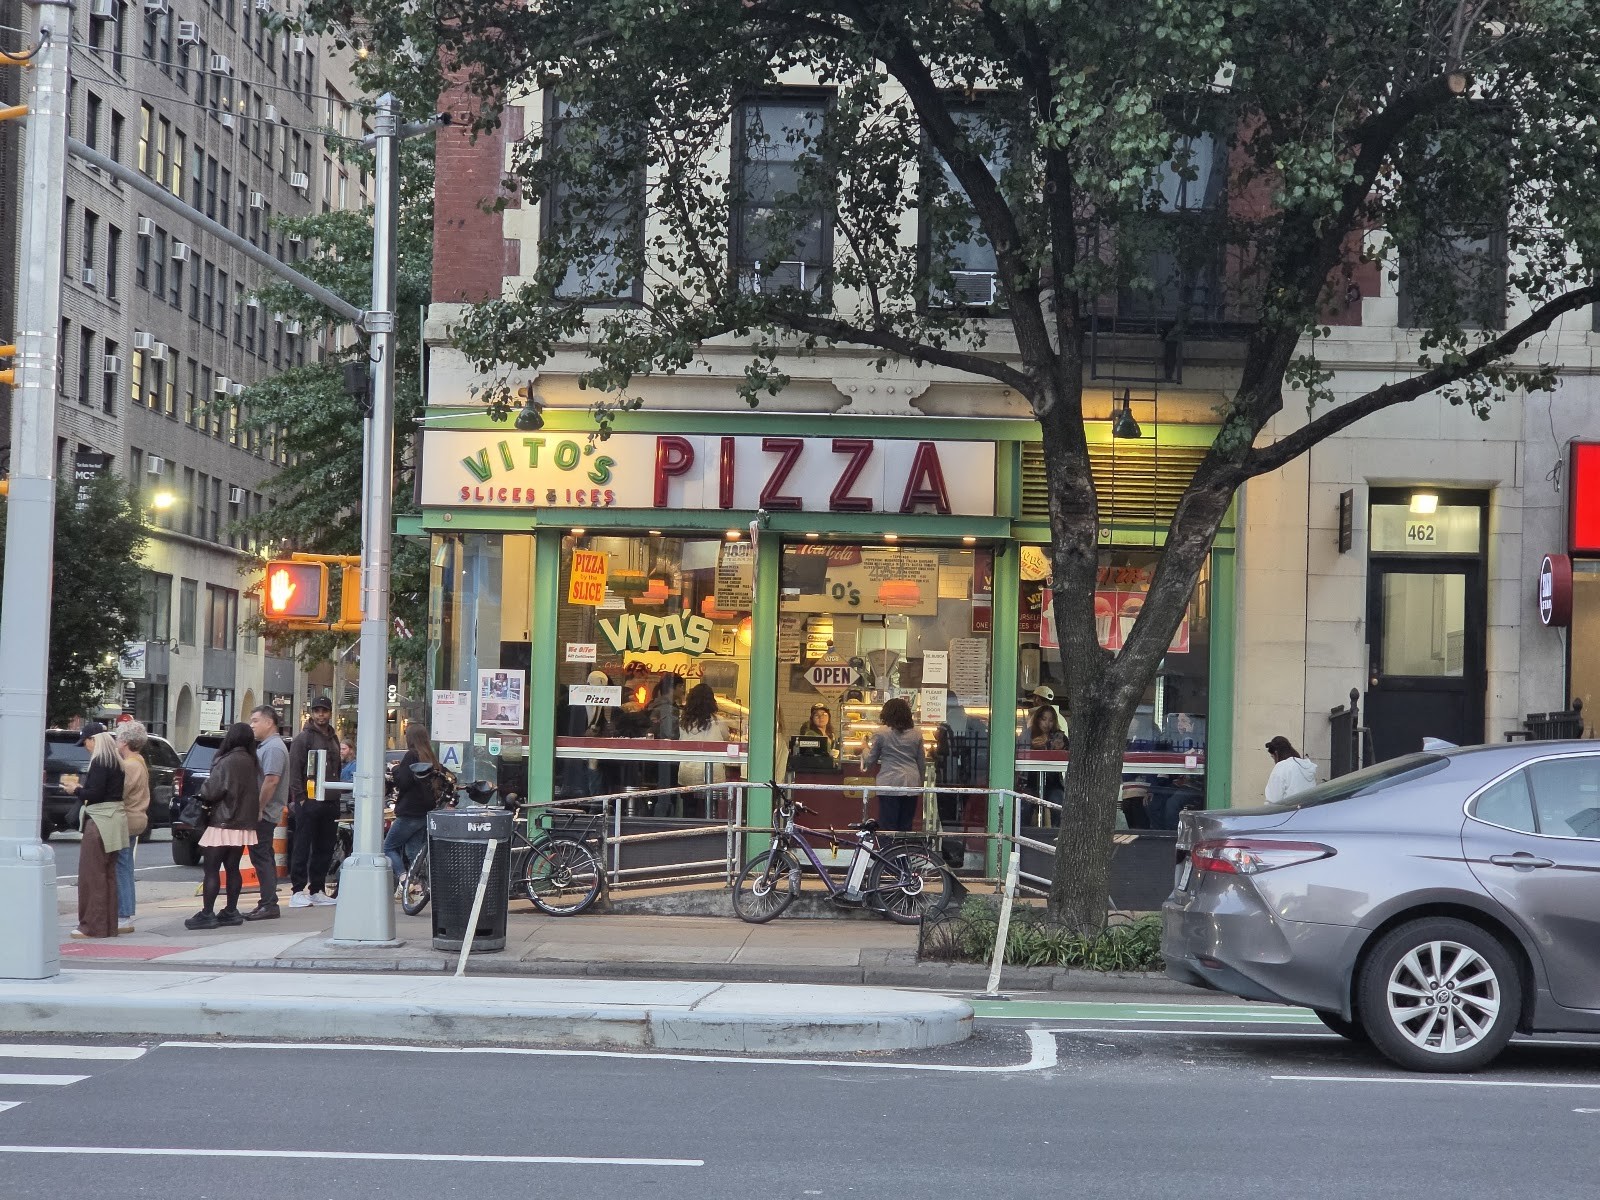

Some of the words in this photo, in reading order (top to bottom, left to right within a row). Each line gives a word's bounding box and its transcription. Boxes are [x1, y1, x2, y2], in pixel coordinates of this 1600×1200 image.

[462, 437, 615, 486] VITO'S
[653, 435, 952, 515] PIZZA
[460, 486, 535, 502] SLICES
[566, 488, 614, 506] ICES
[1407, 524, 1434, 541] 462
[575, 553, 605, 574] PIZZA
[572, 581, 602, 602] SLICE
[830, 580, 861, 606] O'S
[599, 609, 713, 656] VITO'S
[975, 621, 989, 629] ONE
[672, 663, 707, 677] ICES
[813, 667, 851, 684] OPEN
[585, 694, 611, 704] Pizza
[443, 746, 459, 765] A
[467, 822, 492, 832] NYC
